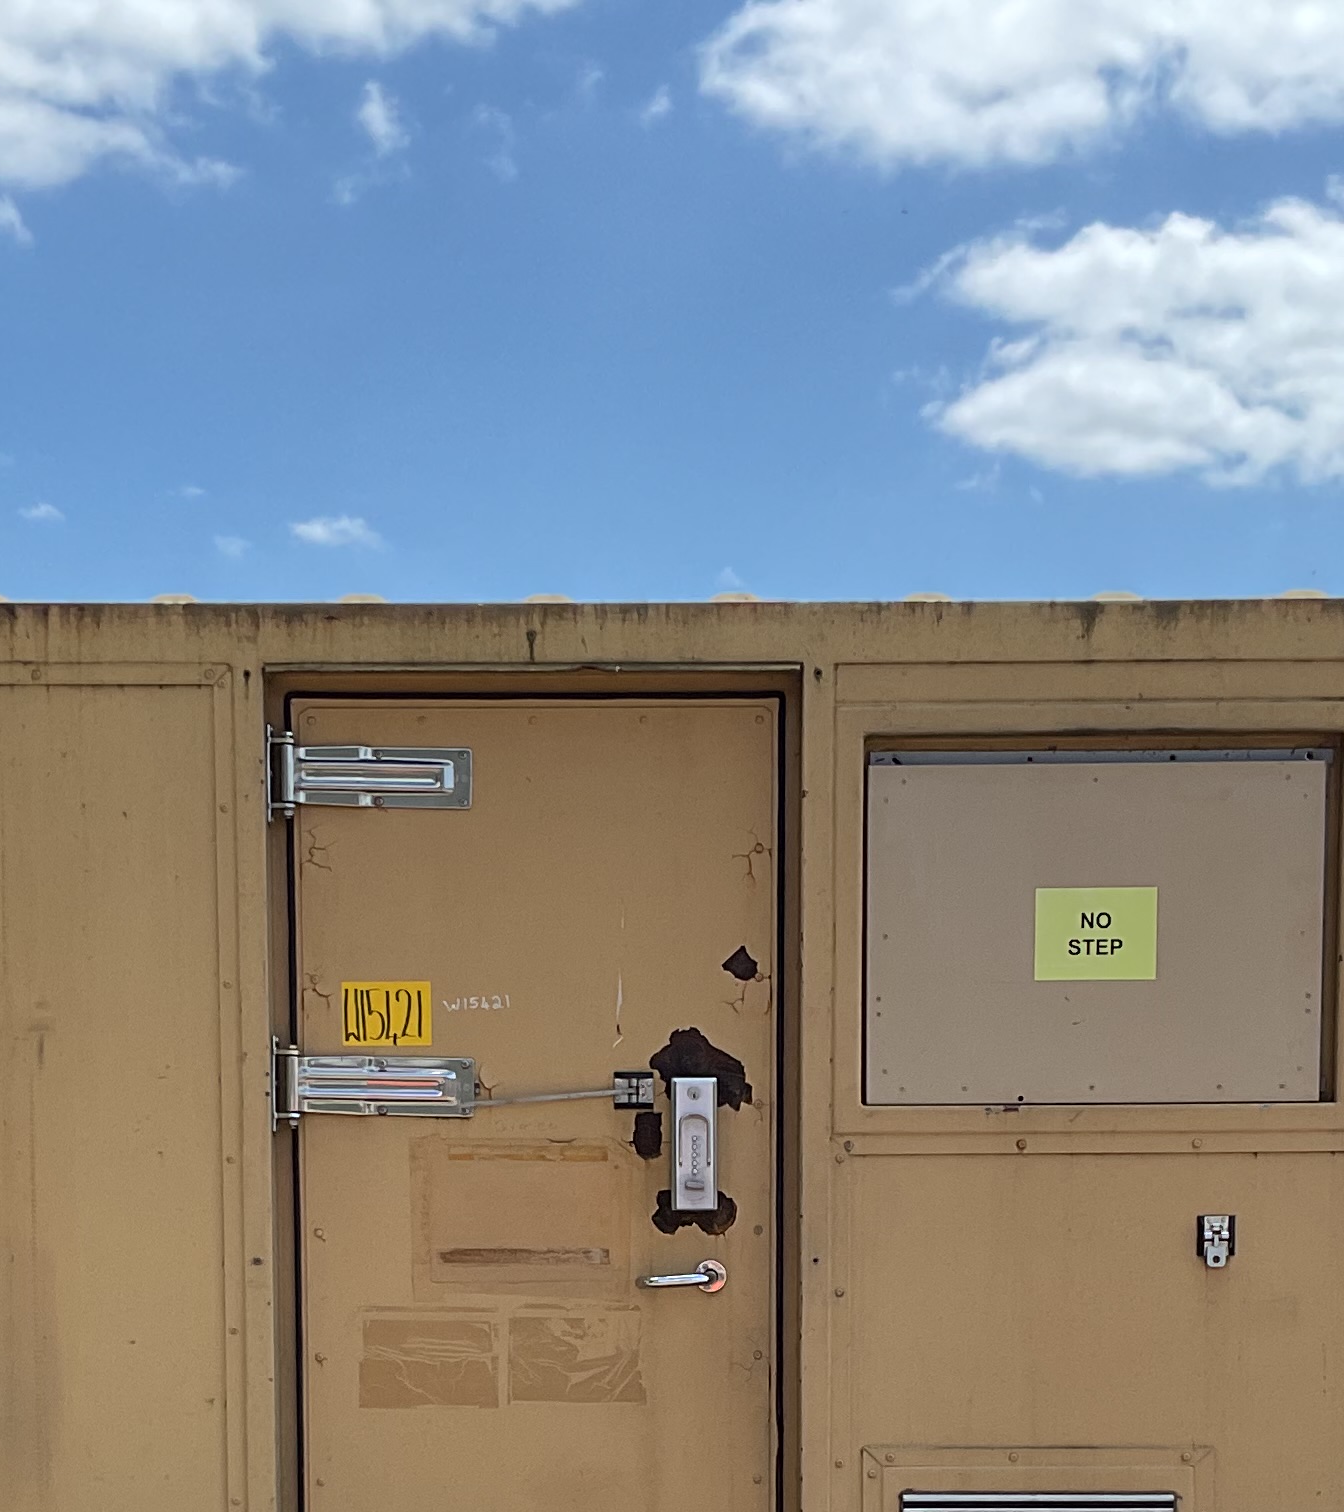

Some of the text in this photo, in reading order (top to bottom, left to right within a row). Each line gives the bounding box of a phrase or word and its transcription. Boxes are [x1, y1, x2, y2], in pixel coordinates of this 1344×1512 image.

[1080, 912, 1112, 929] NO
[1068, 939, 1123, 956] STEP
[443, 994, 511, 1012] W15421
[344, 988, 423, 1046] W15421
